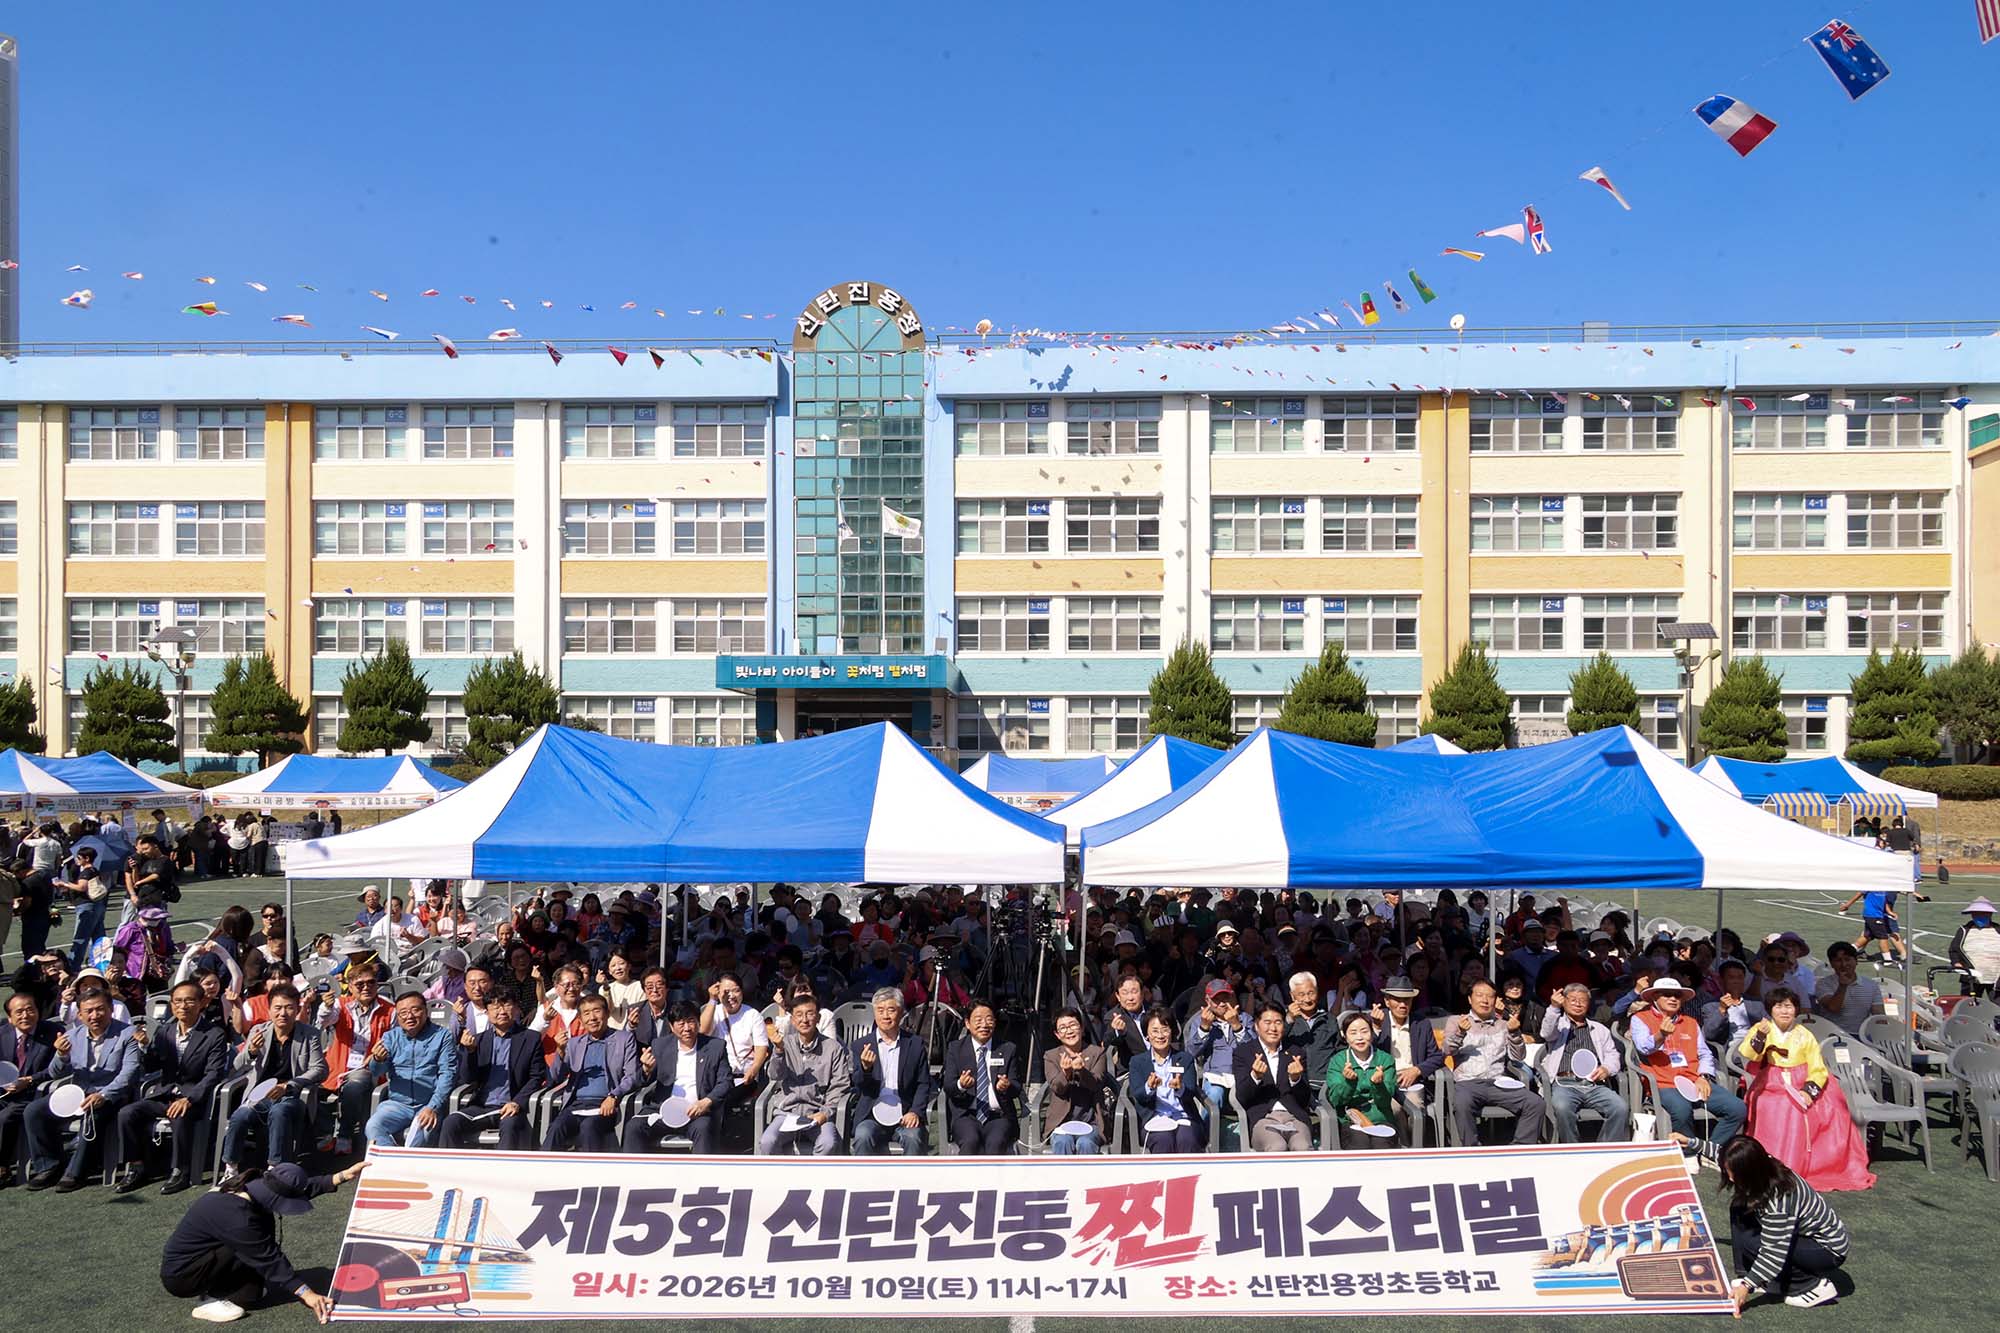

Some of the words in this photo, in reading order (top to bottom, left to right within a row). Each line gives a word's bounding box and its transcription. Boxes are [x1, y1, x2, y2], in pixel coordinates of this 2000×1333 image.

[797, 281, 923, 337] 신탄진용정
[1286, 401, 1302, 410] 5-3
[1545, 400, 1561, 409] 5-2
[1809, 397, 1824, 406] 5-1
[639, 408, 653, 417] 6-1
[1031, 404, 1046, 414] 5-4
[388, 410, 404, 419] 6-2
[1545, 500, 1561, 509] 4-2
[1808, 498, 1824, 507] 4-1
[142, 507, 157, 515] 2-2
[389, 505, 403, 514] 2-1
[1032, 504, 1047, 512] 4-4
[1287, 504, 1302, 513] 4-3
[142, 604, 157, 613] 1-3
[389, 604, 403, 614] 1-2
[1287, 602, 1301, 610] 1-1
[1545, 600, 1561, 609] 2-4
[735, 665, 778, 679] 빛나라
[782, 665, 836, 679] 아이들아
[847, 665, 884, 679] 꽃처럼
[889, 665, 926, 678] 별처럼
[242, 796, 294, 805] 그리미공방
[516, 1186, 752, 1258] 제5회
[762, 1187, 1072, 1263] 신탄진동
[1073, 1174, 1212, 1268] 찐
[1213, 1177, 1547, 1257] 페스티벌
[572, 1272, 648, 1297] 일시:
[658, 1275, 775, 1298] 2026년
[787, 1276, 851, 1299] 10월
[862, 1276, 977, 1300] 10일(토)
[987, 1276, 1126, 1300] 11시~17시
[1164, 1275, 1237, 1298] 장소:
[1246, 1269, 1500, 1297] 신탄진용정초등학교
